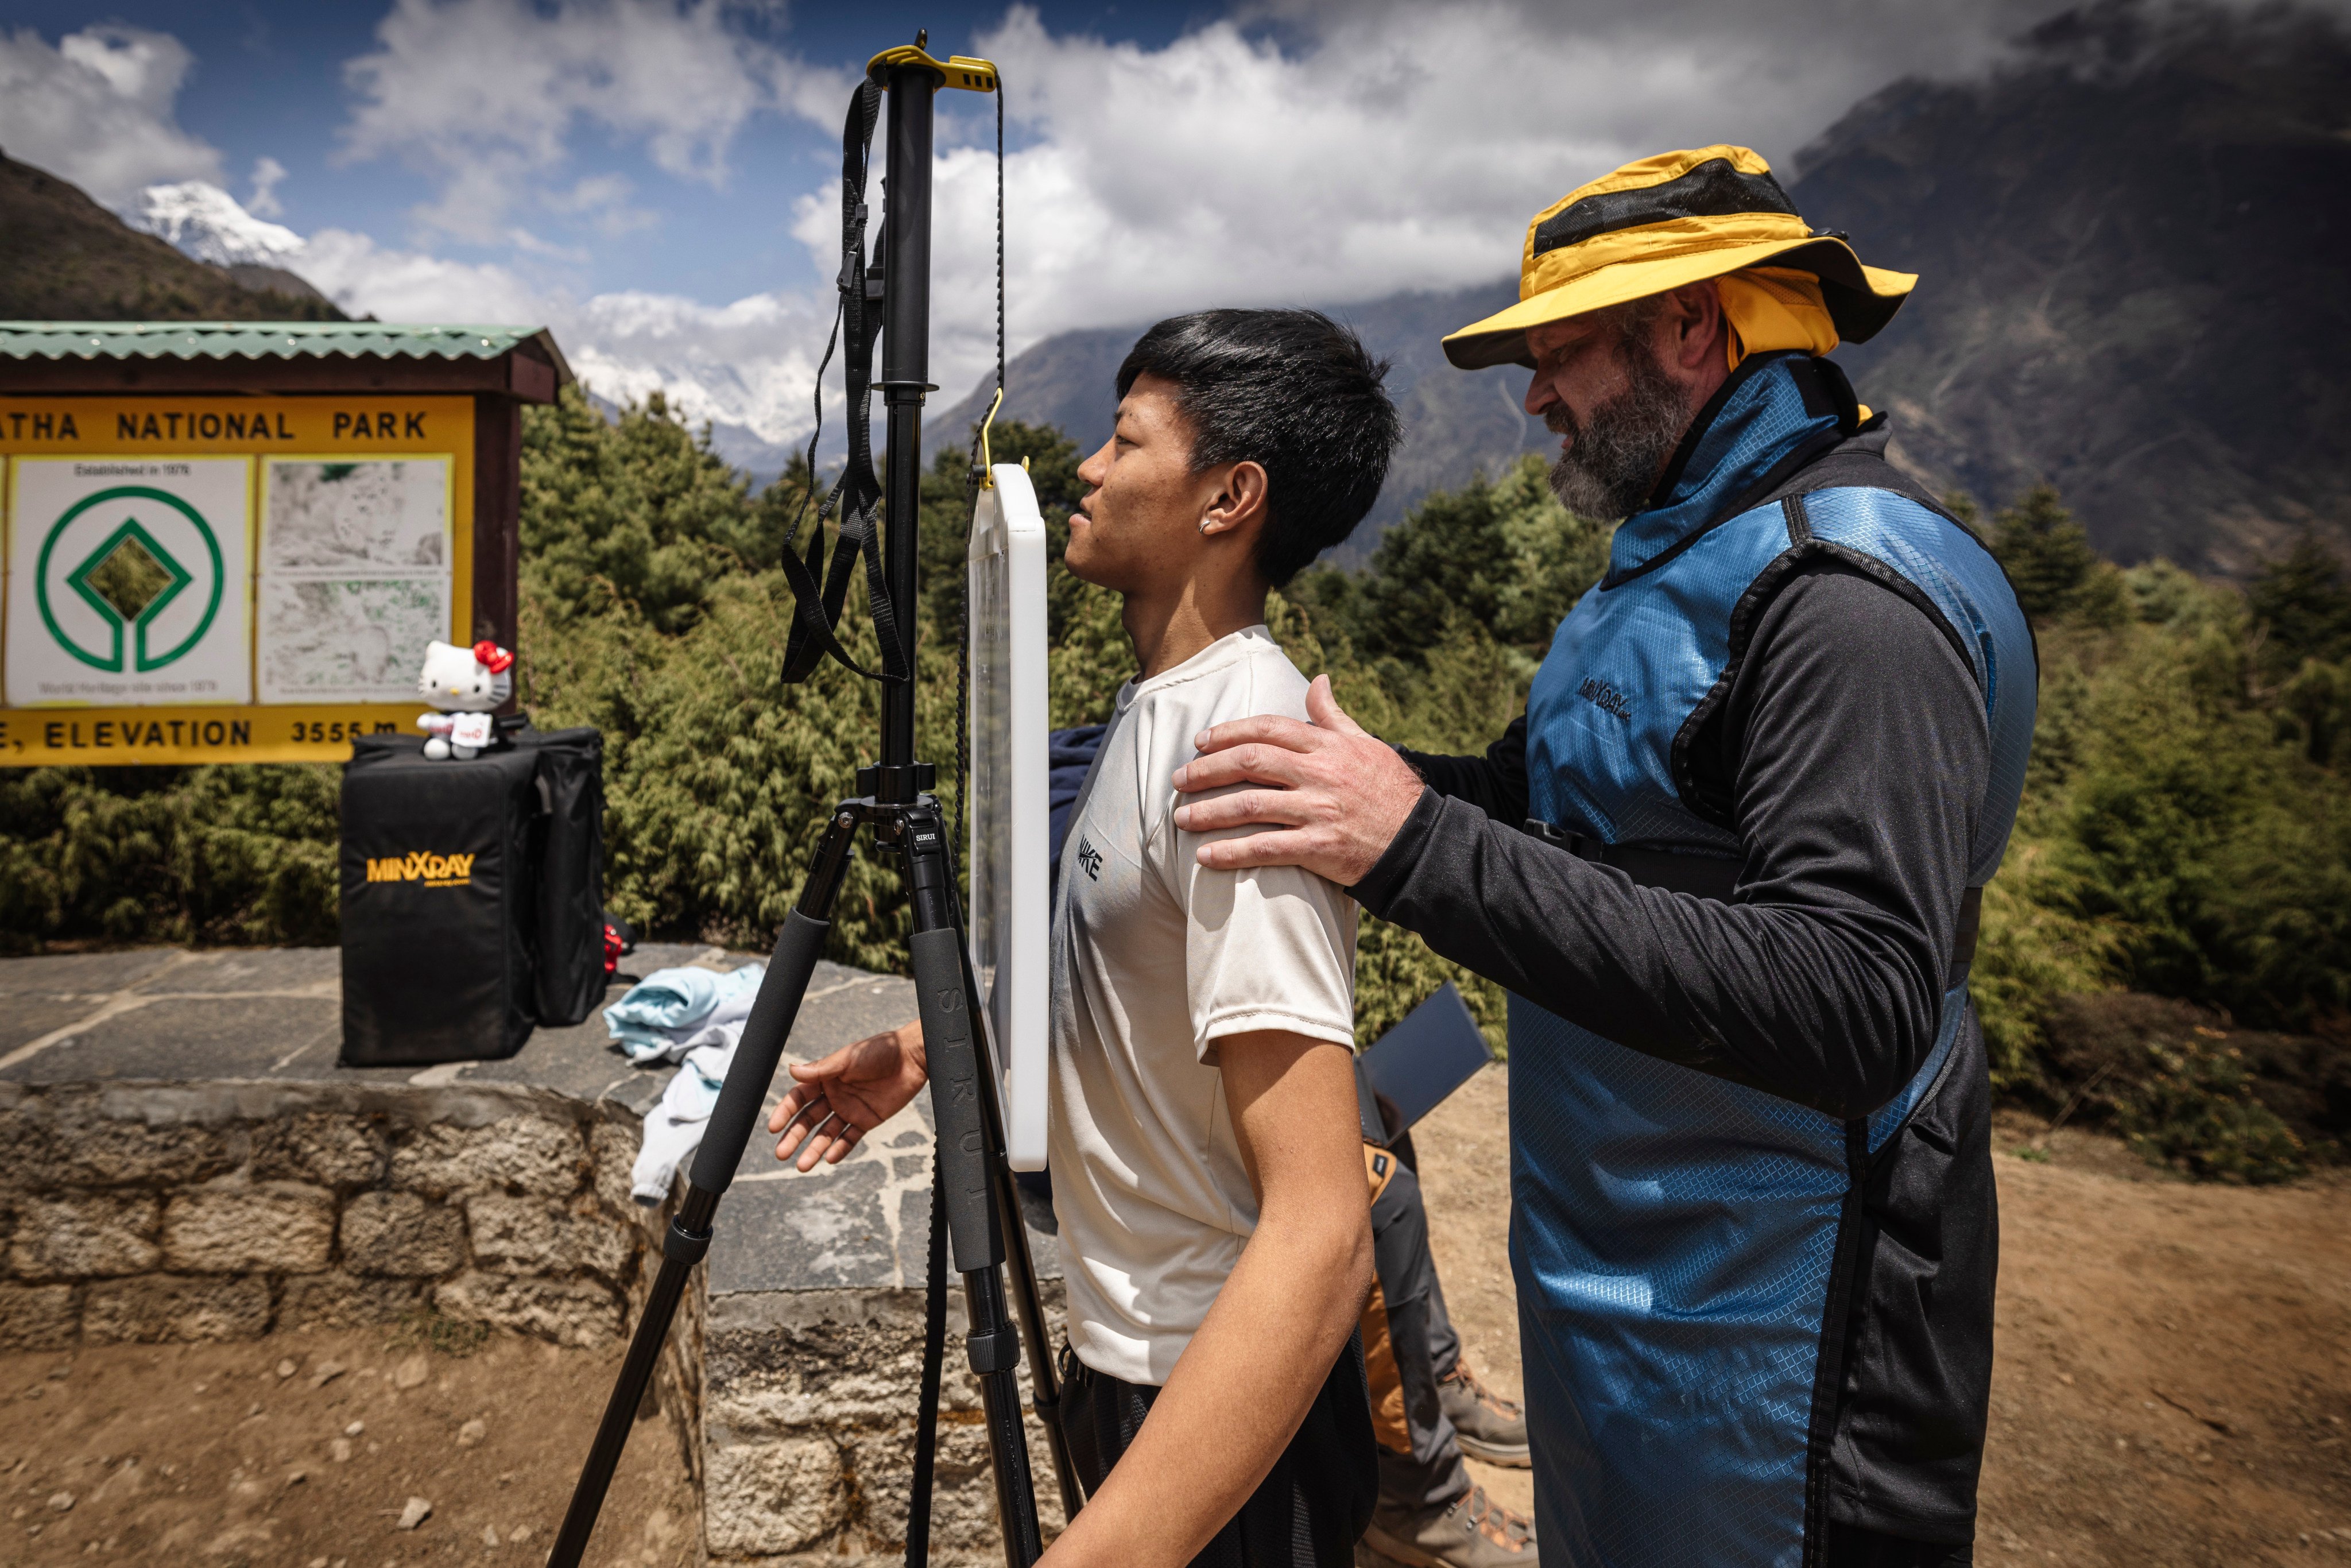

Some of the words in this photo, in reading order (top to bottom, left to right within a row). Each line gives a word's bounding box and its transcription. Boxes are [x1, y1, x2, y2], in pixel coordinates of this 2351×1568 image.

[0, 413, 79, 440] THA
[117, 412, 294, 440] NATIONAL
[333, 411, 427, 439] PARK
[45, 719, 251, 748] ELEVATION
[291, 722, 362, 742] 3555
[916, 833, 936, 842] SIRUI
[366, 850, 475, 882] MINXRAY
[1077, 834, 1103, 882] NIKE
